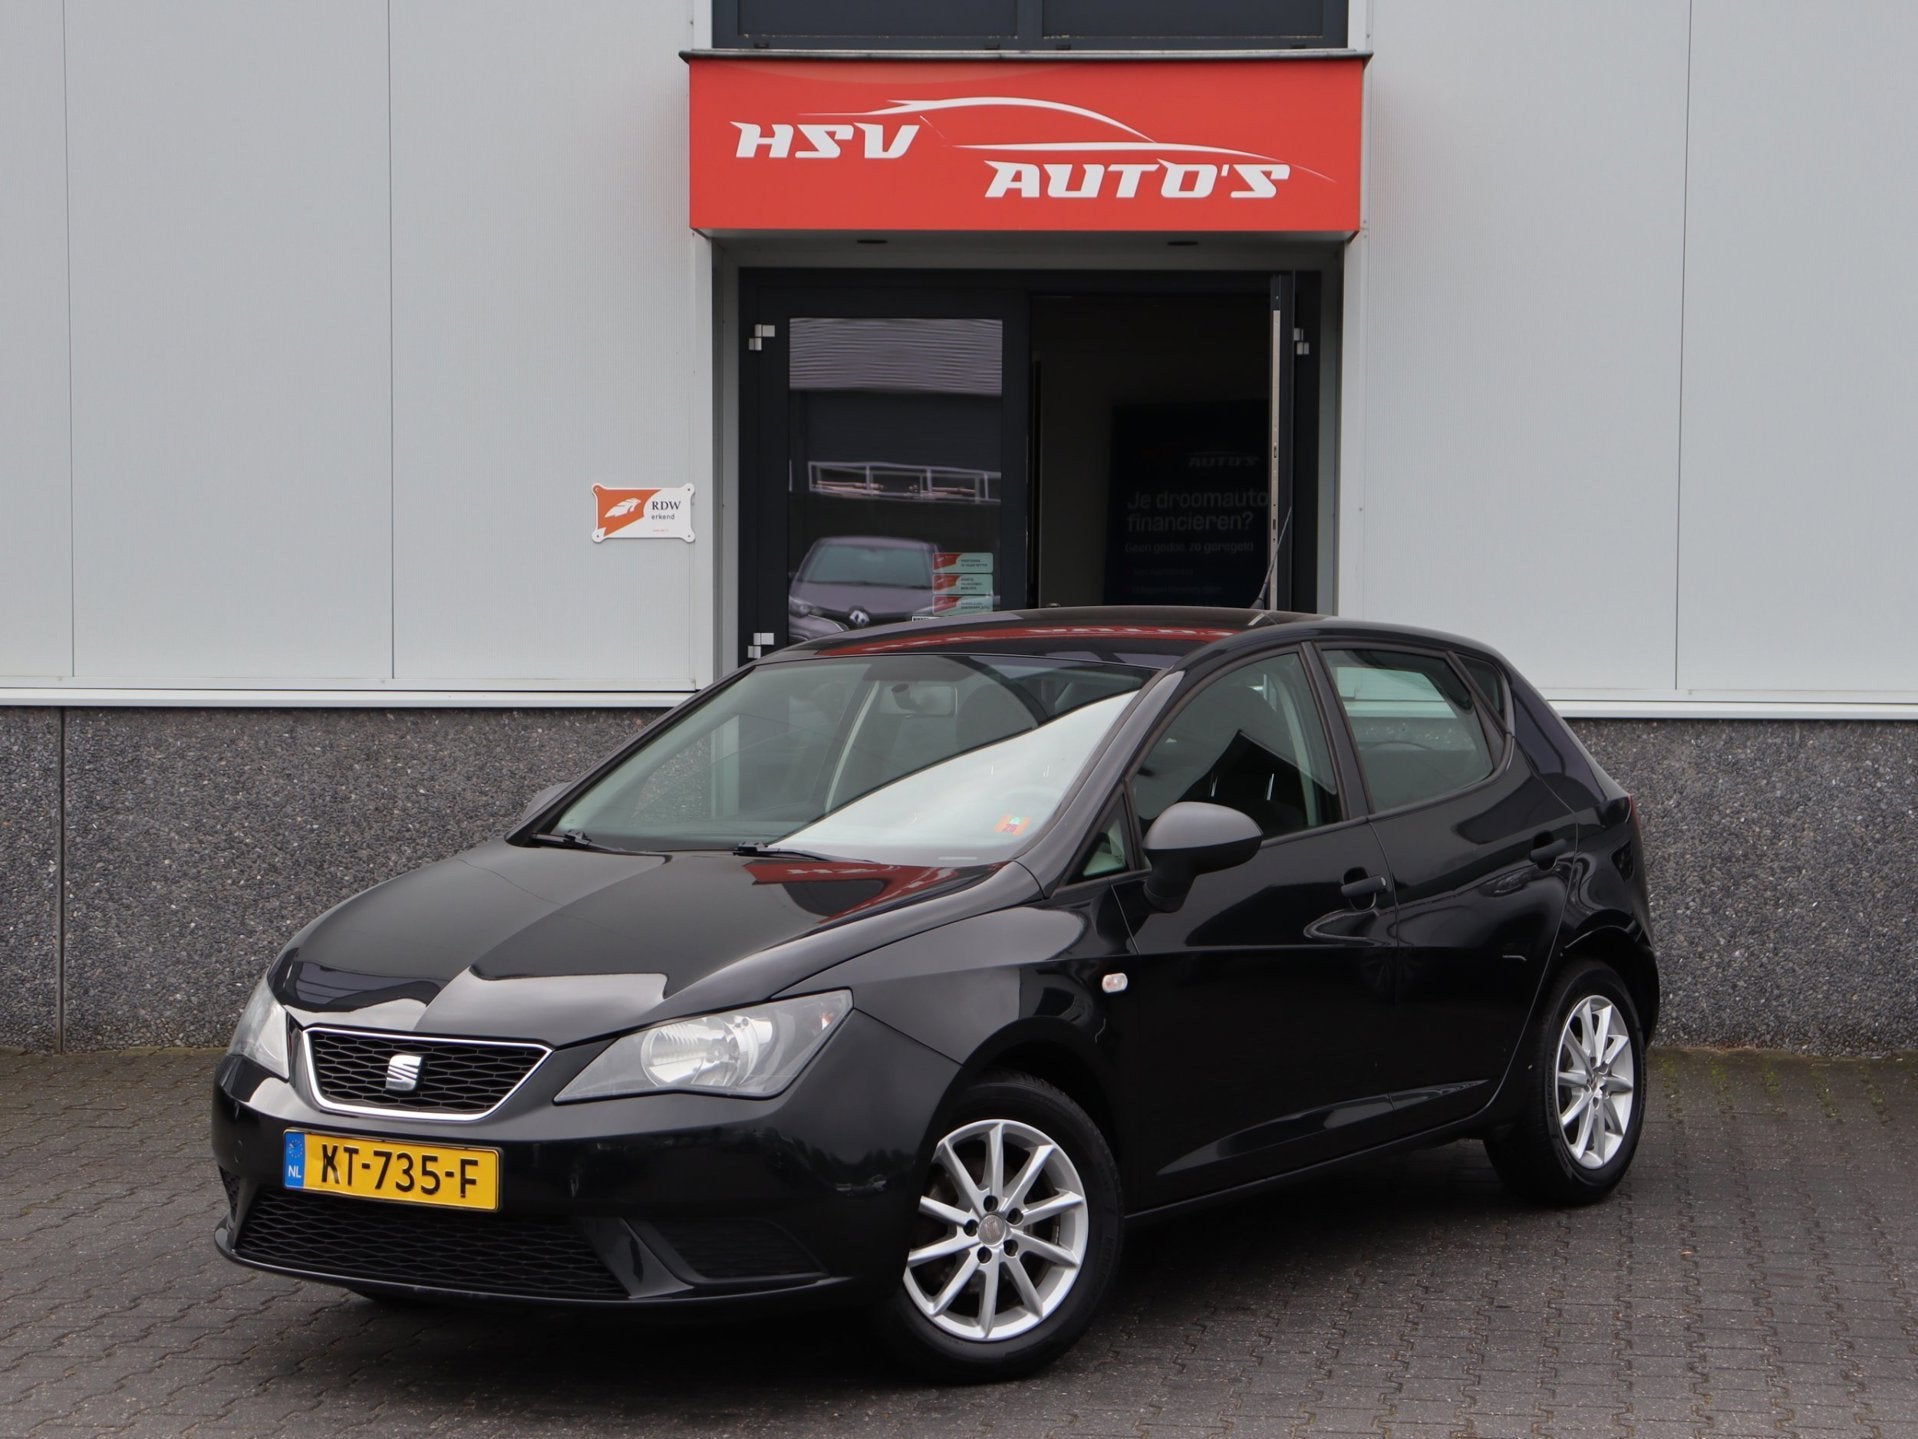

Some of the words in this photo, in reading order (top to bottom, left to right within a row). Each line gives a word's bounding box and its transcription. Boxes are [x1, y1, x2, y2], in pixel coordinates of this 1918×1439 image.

[729, 120, 920, 159] HSV
[983, 159, 1291, 199] AUTO'S
[651, 500, 681, 511] RDW
[651, 513, 676, 521] erkend
[1126, 511, 1255, 533] financieren?
[287, 1165, 302, 1179] NL
[321, 1144, 479, 1199] KT-735-F
